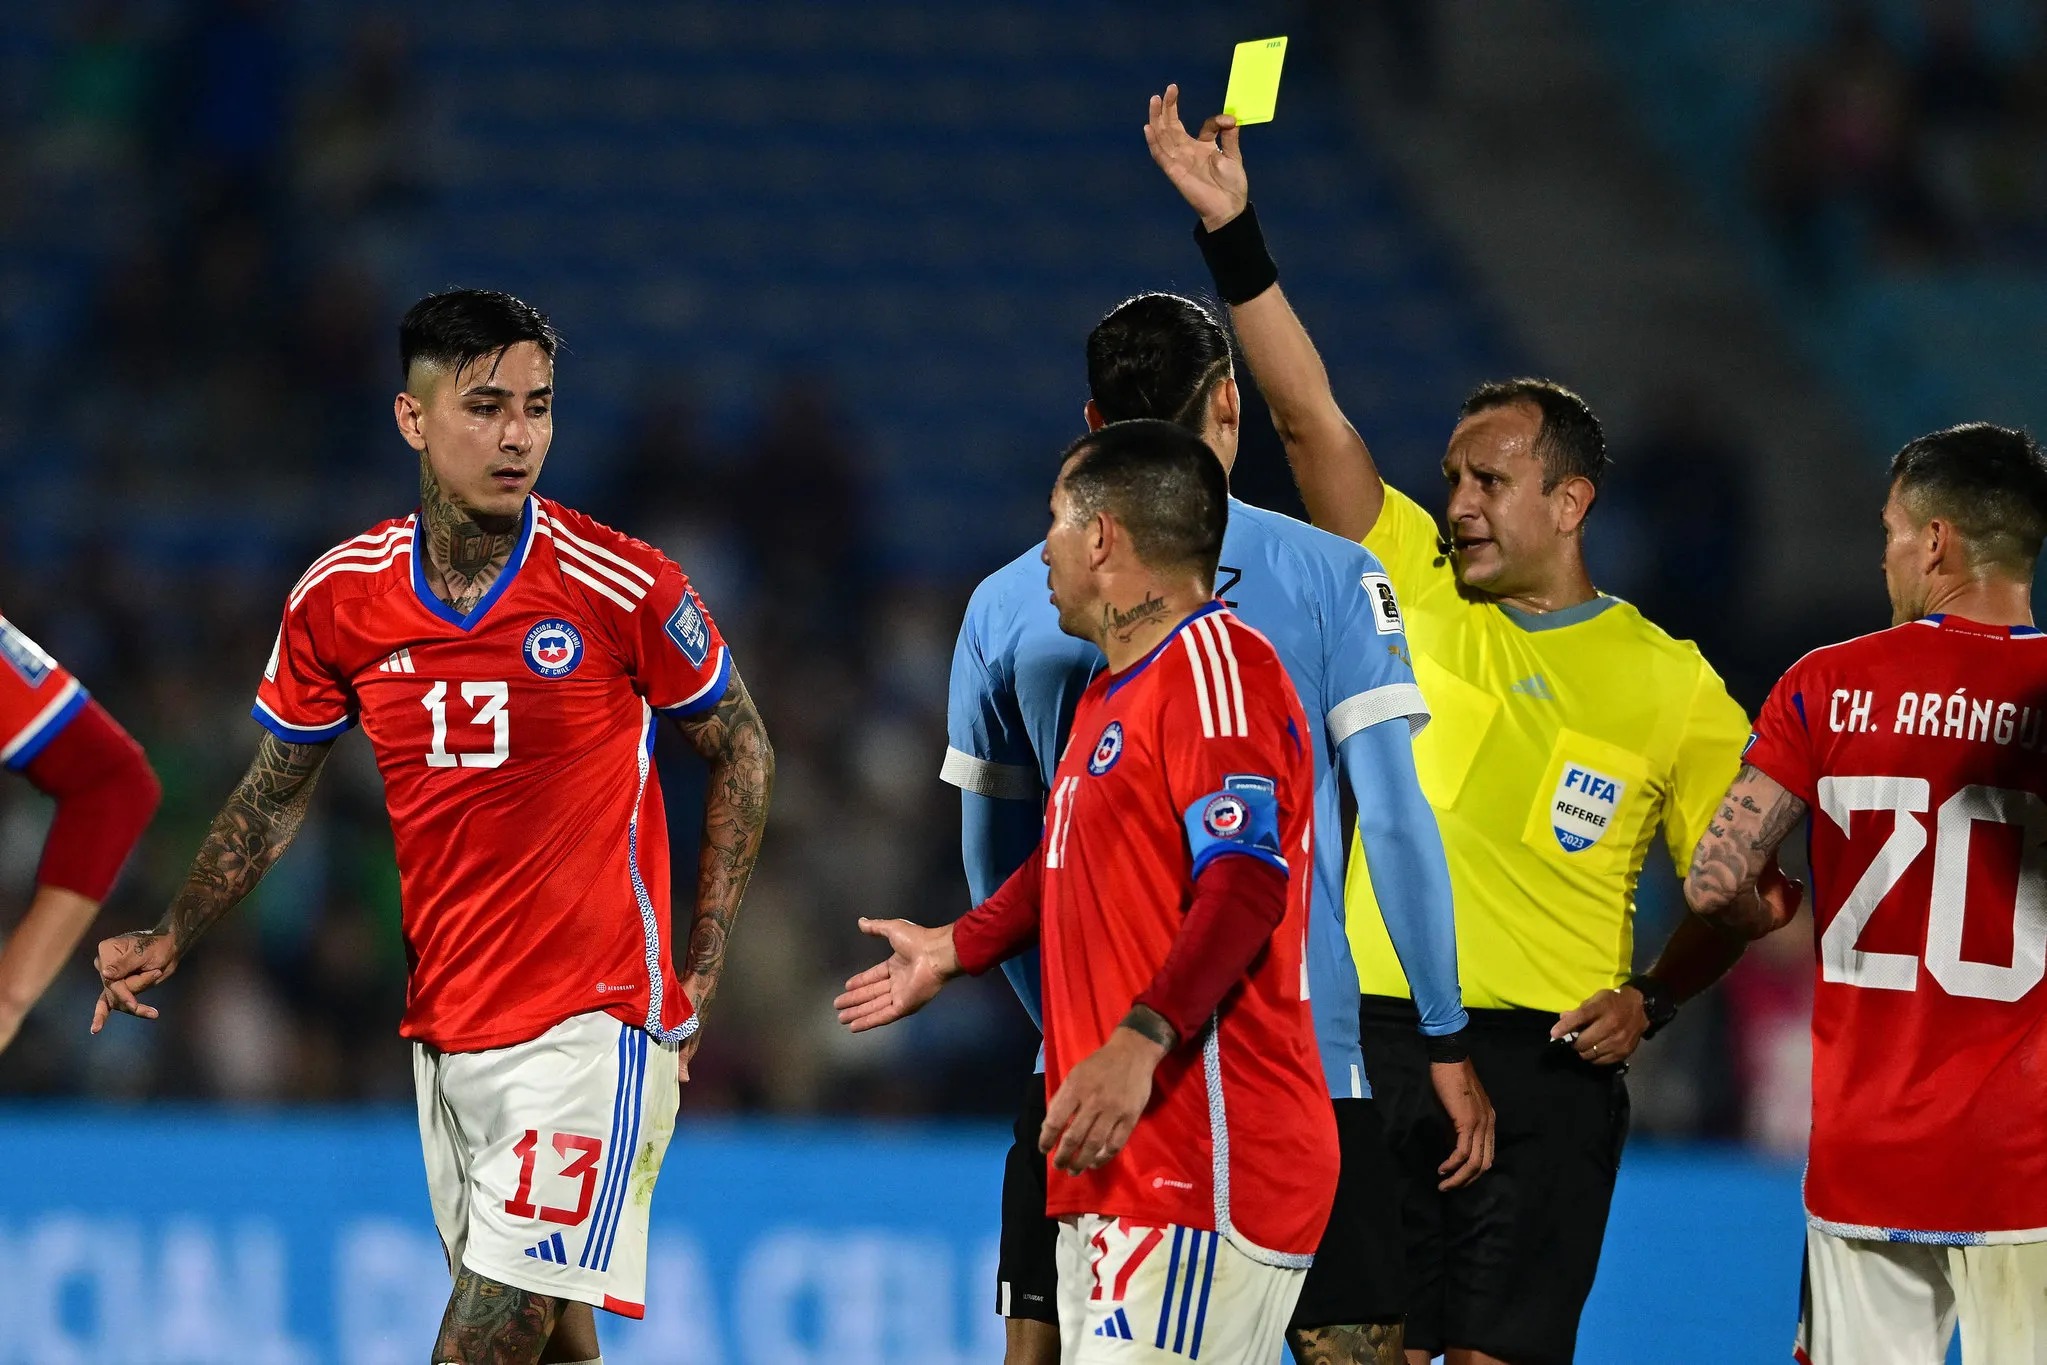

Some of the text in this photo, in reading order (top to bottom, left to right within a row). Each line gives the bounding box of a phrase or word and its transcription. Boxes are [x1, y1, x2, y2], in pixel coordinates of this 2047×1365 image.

[680, 608, 698, 638] UNITES
[540, 666, 570, 675] DE CHILE
[421, 681, 509, 769] 13
[1829, 687, 2047, 753] CH. ARÁNGU
[1565, 768, 1615, 804] FIFA
[1556, 801, 1607, 828] REFEREE
[1560, 833, 1585, 848] 2023
[1817, 776, 2047, 1002] 20
[505, 1129, 602, 1227] 13
[1090, 1217, 1168, 1300] 17
